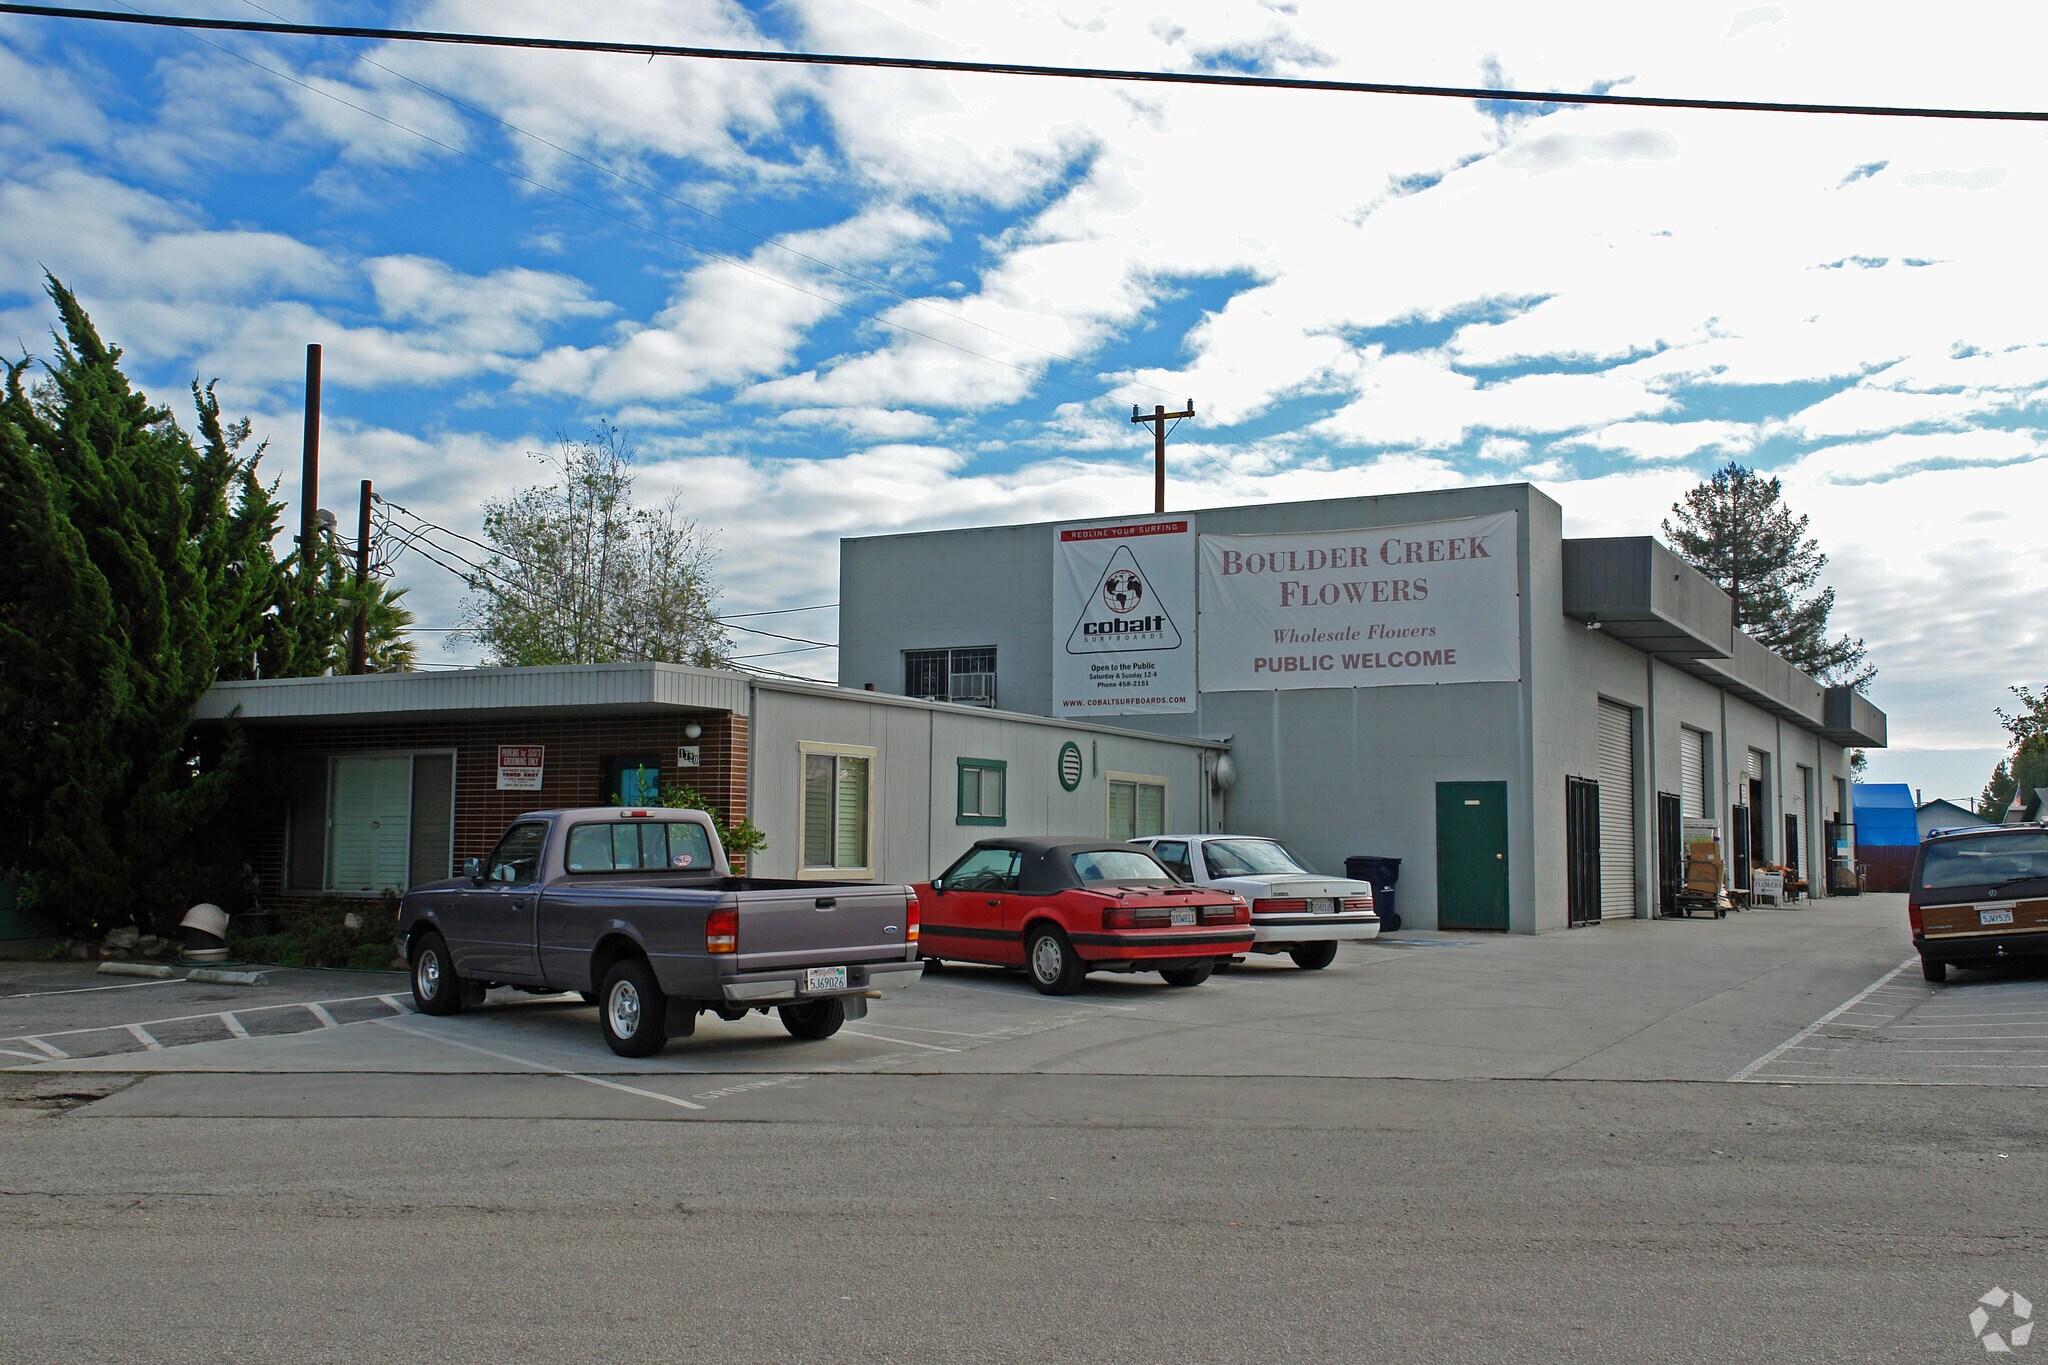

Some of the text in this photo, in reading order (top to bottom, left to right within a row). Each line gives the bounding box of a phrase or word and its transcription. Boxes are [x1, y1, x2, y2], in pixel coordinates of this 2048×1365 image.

[1071, 523, 1178, 538] REDLINE YOUR SURFING
[1221, 535, 1492, 576] BOULDER CREEK
[1279, 577, 1428, 608] FLOWERS
[1083, 616, 1166, 634] cobalt
[1084, 632, 1163, 643] SURFBOARDS
[1273, 624, 1436, 645] Wholesale Flowers
[1091, 663, 1109, 673] Open
[1133, 662, 1155, 670] Public
[1254, 649, 1456, 673] PUBLIC WELCOME
[1089, 672, 1114, 681] Saturday
[1121, 672, 1142, 680] Sunday
